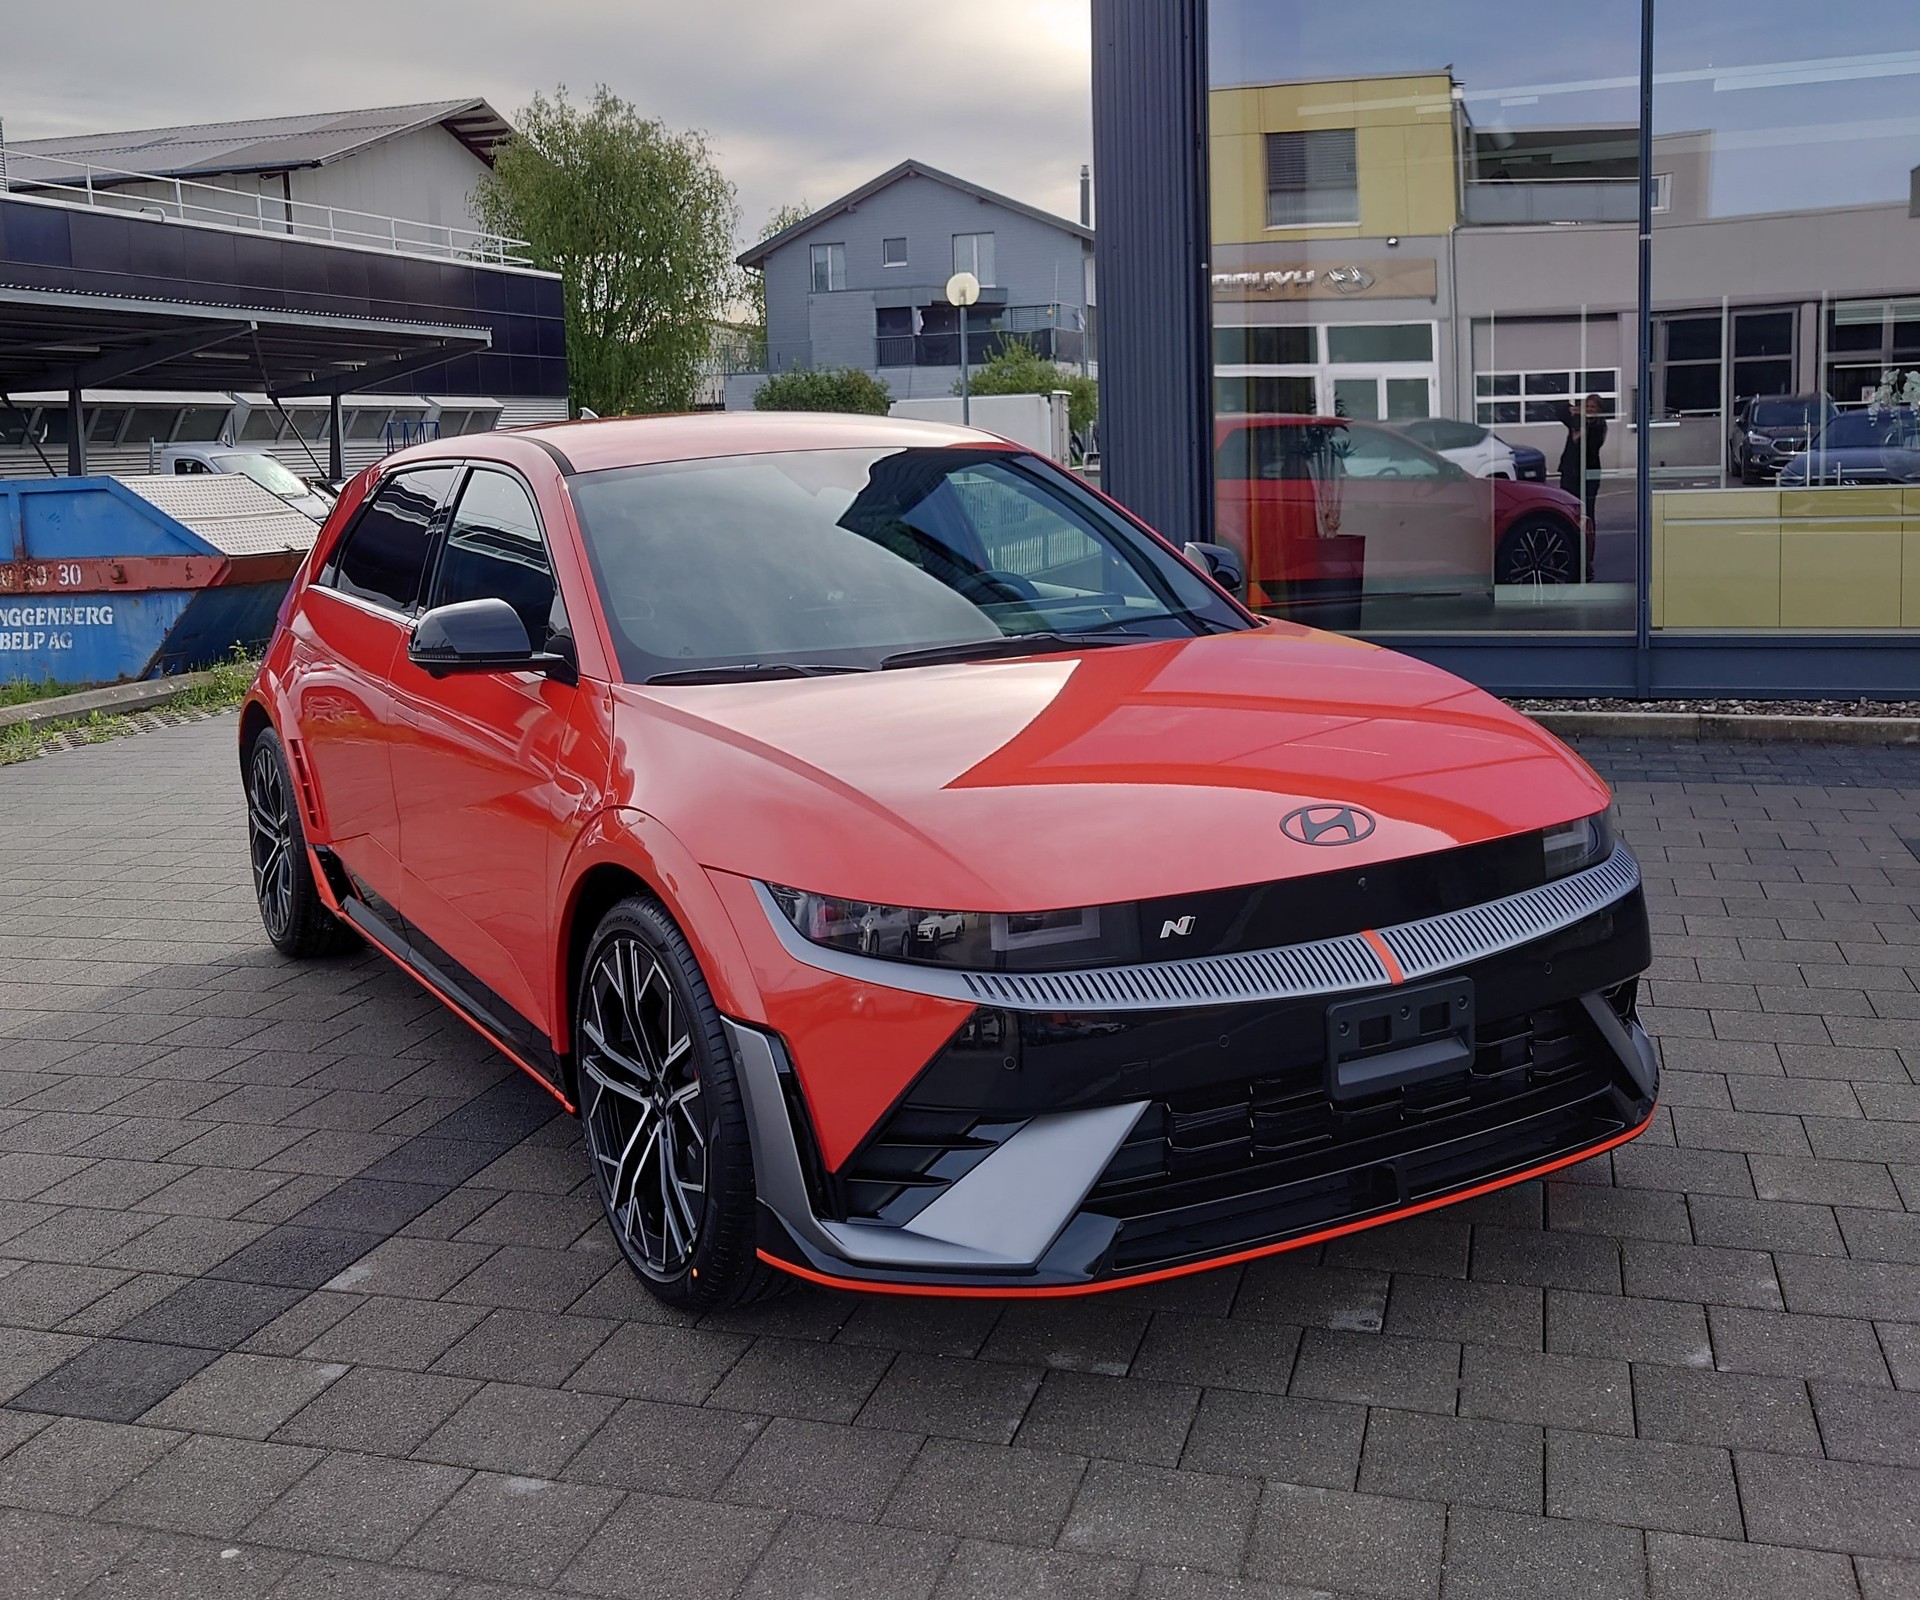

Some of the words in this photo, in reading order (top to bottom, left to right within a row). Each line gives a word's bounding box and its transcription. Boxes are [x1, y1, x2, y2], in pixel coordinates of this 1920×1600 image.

[58, 564, 82, 586] 30
[0, 631, 46, 650] BELP
[48, 631, 73, 650] AG
